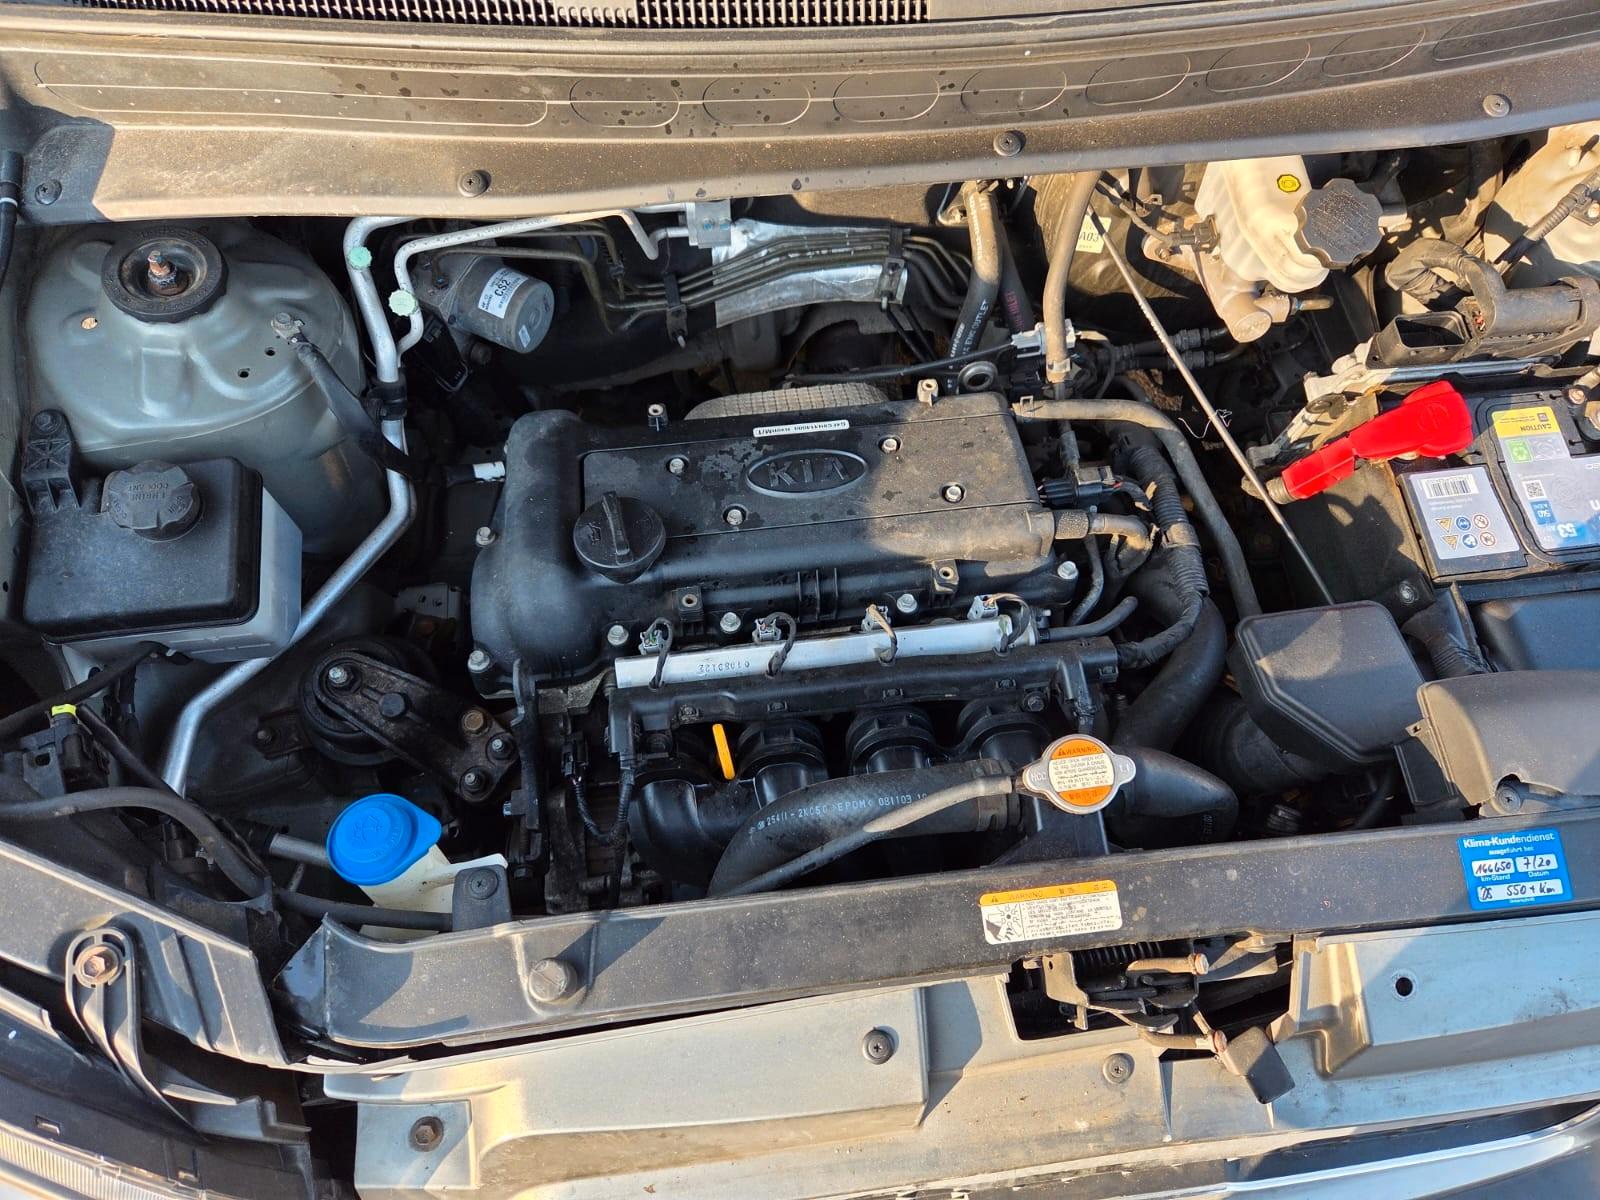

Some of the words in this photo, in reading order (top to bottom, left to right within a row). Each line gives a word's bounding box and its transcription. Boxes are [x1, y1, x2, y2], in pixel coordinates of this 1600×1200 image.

[494, 279, 510, 297] CS2
[972, 299, 989, 329] OUTLET
[1520, 423, 1552, 432] CAUTION
[767, 456, 849, 488] KIA
[1557, 522, 1578, 538] 53
[1067, 746, 1097, 755] WARNING
[878, 794, 912, 807] 081103
[1463, 832, 1555, 848] Klima-Kundendienst
[1523, 856, 1551, 869] 7/20
[1528, 870, 1549, 878] Datum
[1506, 883, 1527, 897] 550
